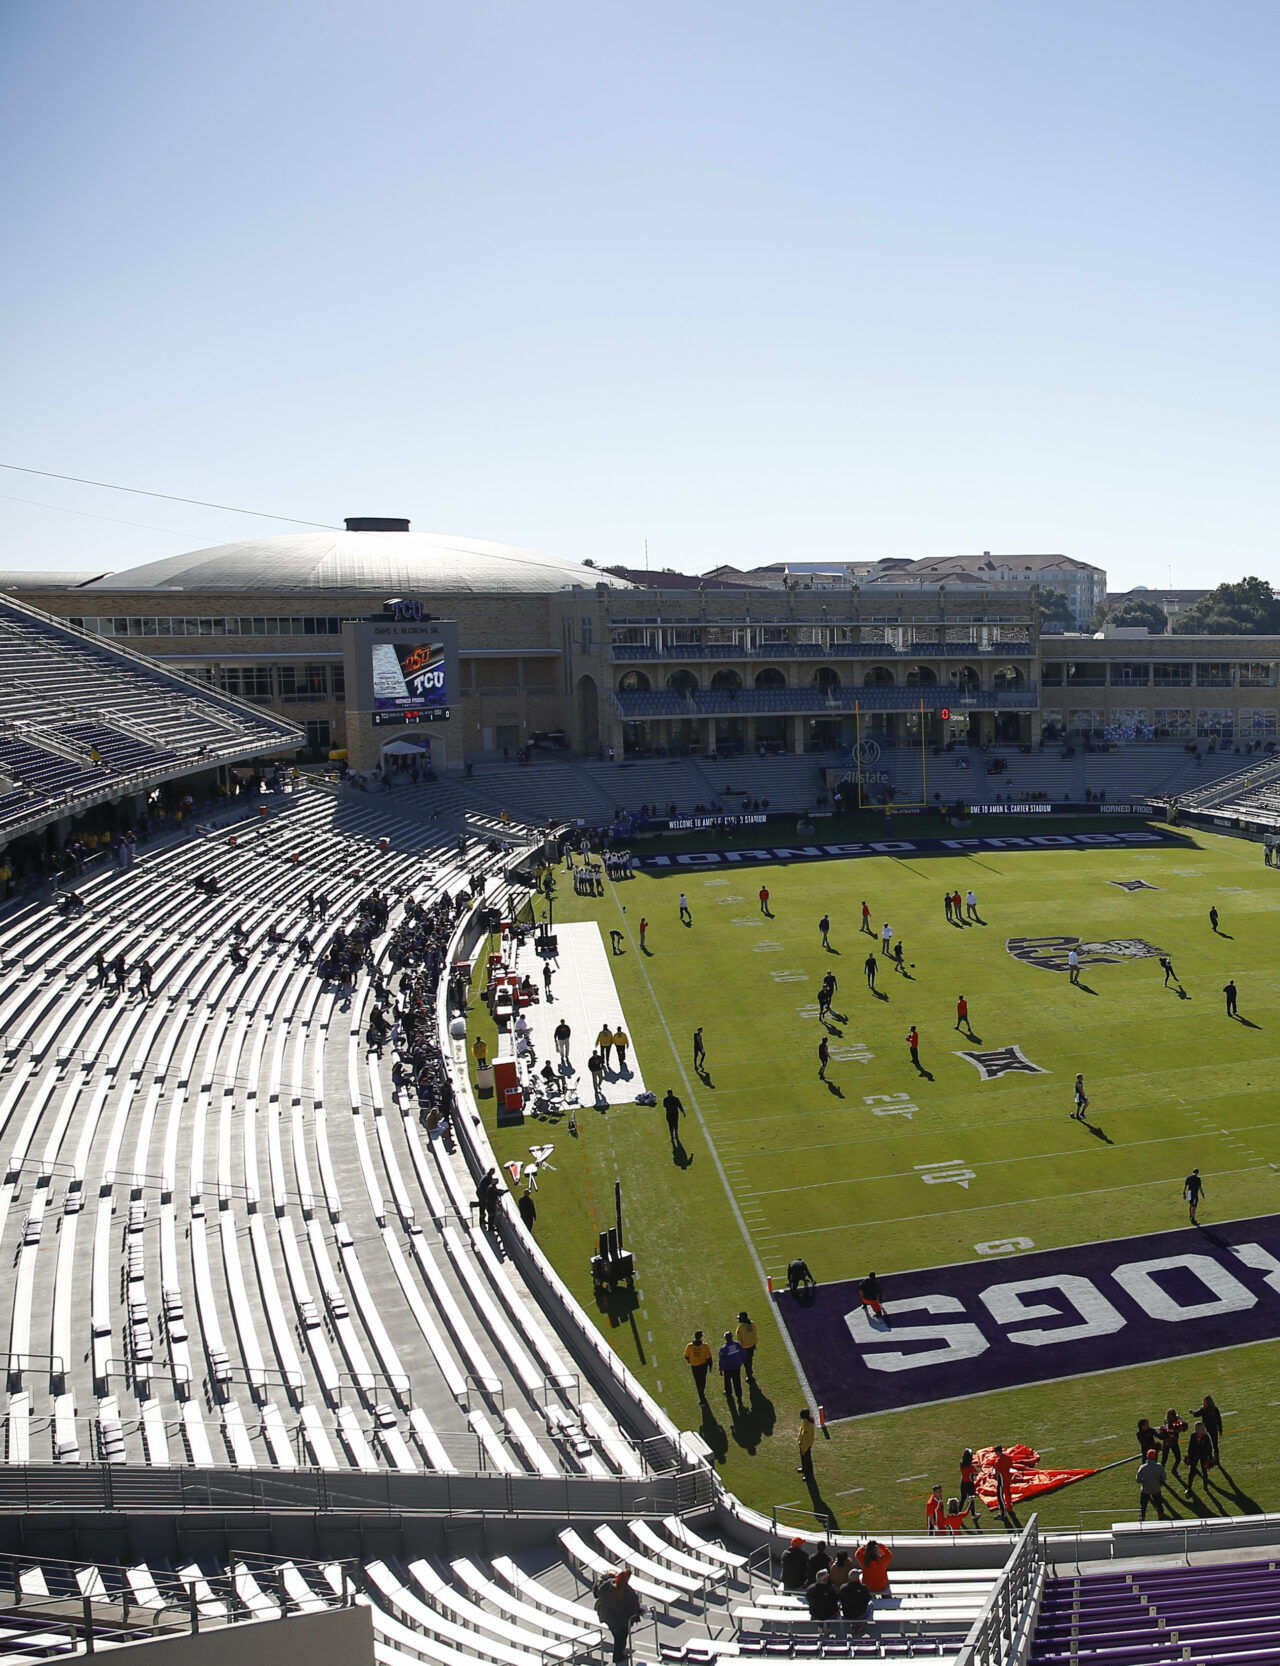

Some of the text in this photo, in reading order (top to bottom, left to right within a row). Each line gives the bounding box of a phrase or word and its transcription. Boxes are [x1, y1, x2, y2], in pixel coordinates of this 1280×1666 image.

[392, 599, 424, 620] TCU
[414, 671, 445, 695] TCU
[841, 771, 888, 784] Allstate
[982, 805, 988, 813] TO
[989, 805, 1003, 813] AMON
[1011, 804, 1029, 812] CARTER
[1030, 804, 1051, 812] STADIUM
[1100, 805, 1131, 813] HORNED
[632, 832, 1164, 868] HORNED FROGS
[862, 1092, 920, 1116] 20
[913, 1159, 977, 1185] 10
[973, 1236, 1036, 1255] G
